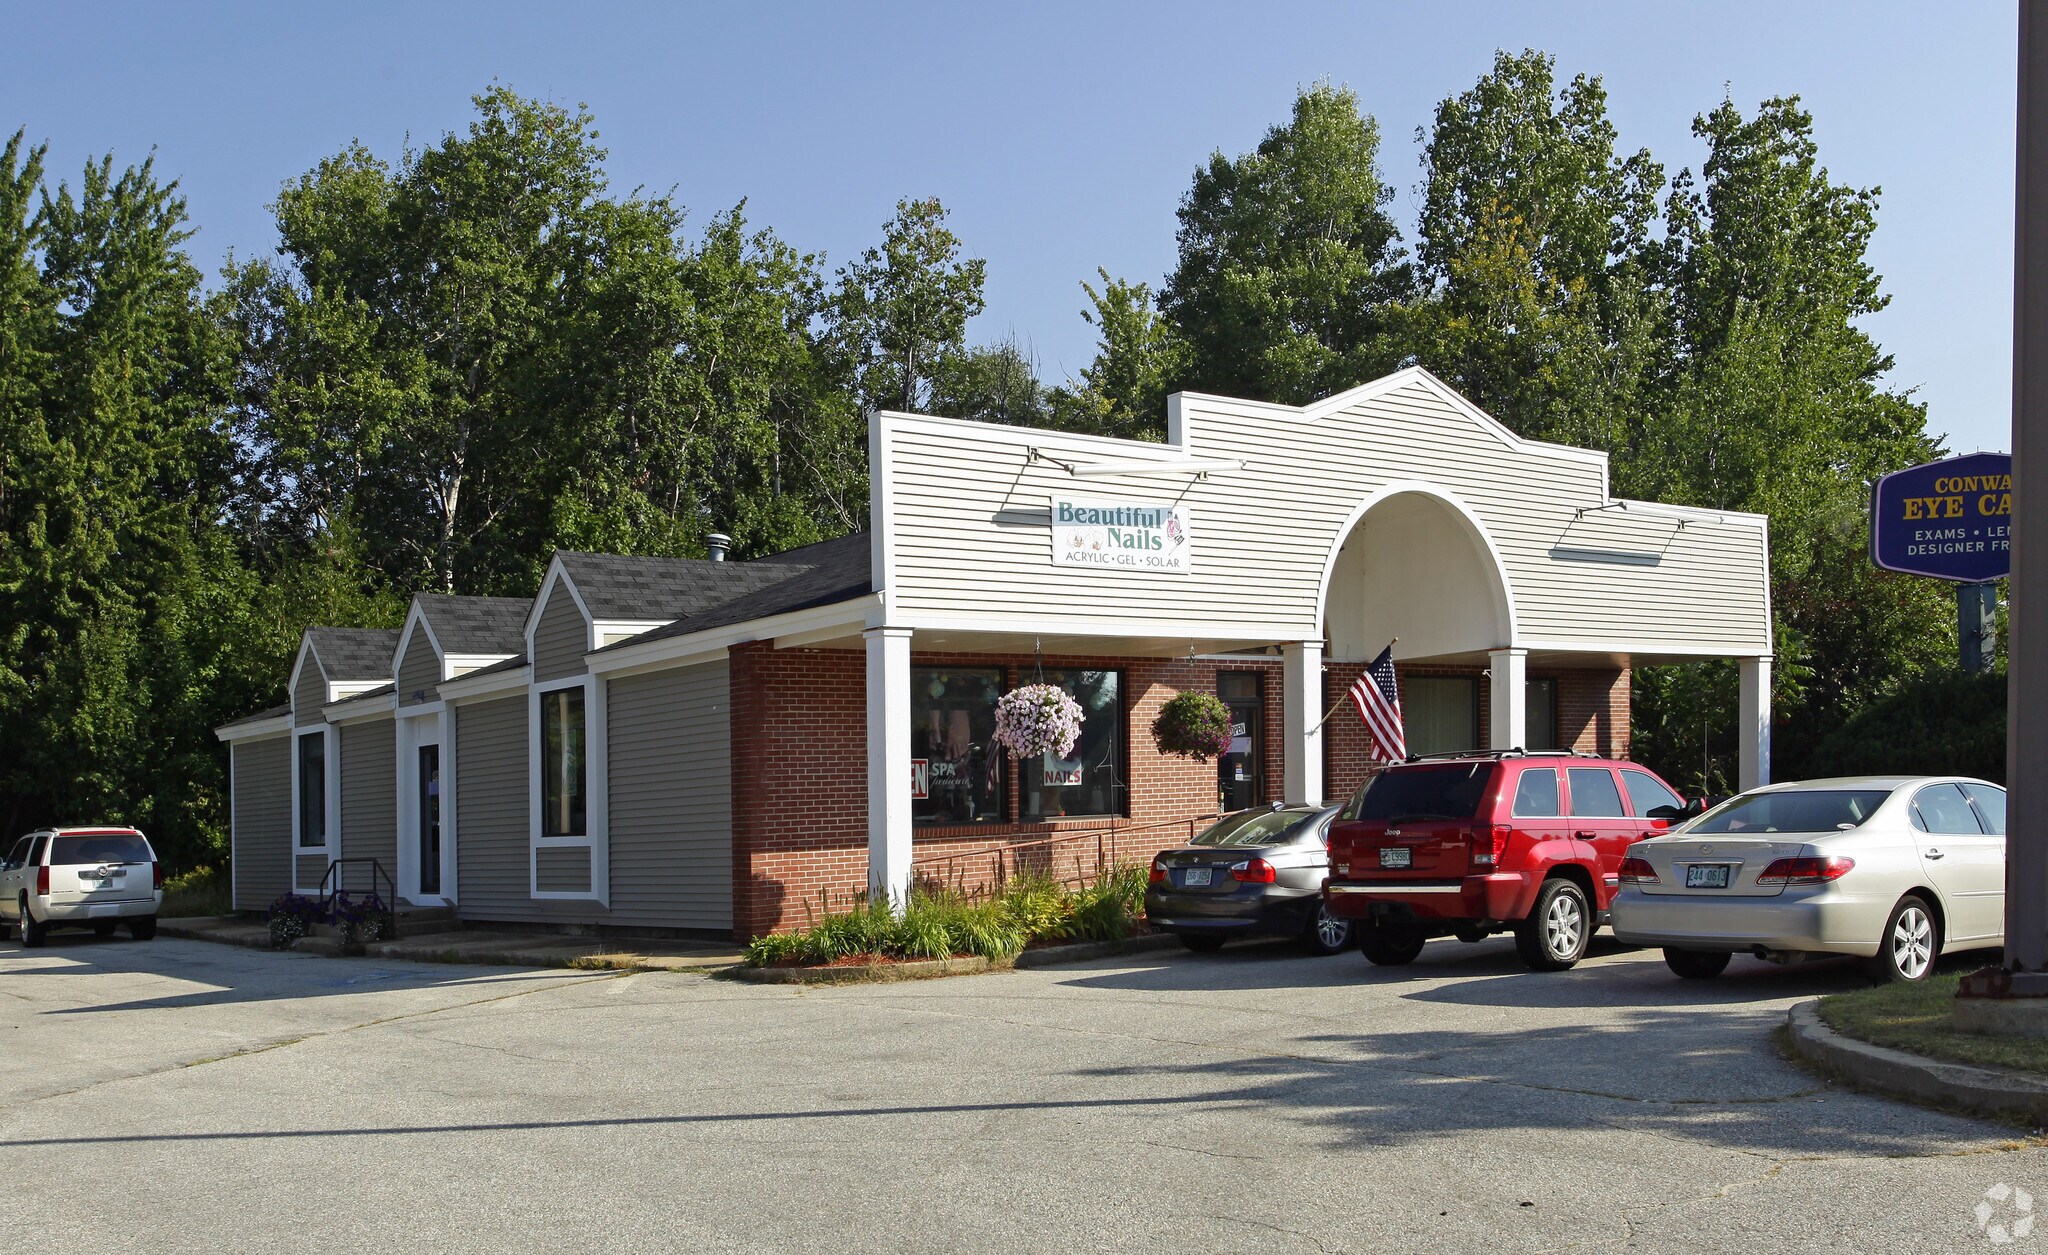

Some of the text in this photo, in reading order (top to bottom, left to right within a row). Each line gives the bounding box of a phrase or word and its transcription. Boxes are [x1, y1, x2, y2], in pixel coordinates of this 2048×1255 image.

[1935, 474, 2012, 494] CONWA
[1903, 493, 2012, 520] EYE CA
[1058, 501, 1161, 529] Beautiful
[1107, 527, 1162, 551] Nails
[1915, 528, 1966, 541] EXAMS
[1908, 540, 2010, 556] DESIGNER FR
[1065, 551, 1180, 568] ACRYLIC GEL SOLAR
[931, 762, 956, 776] SPA
[1045, 769, 1081, 784] NAILS
[1384, 829, 1401, 837] Jeep
[1689, 869, 1703, 881] 244
